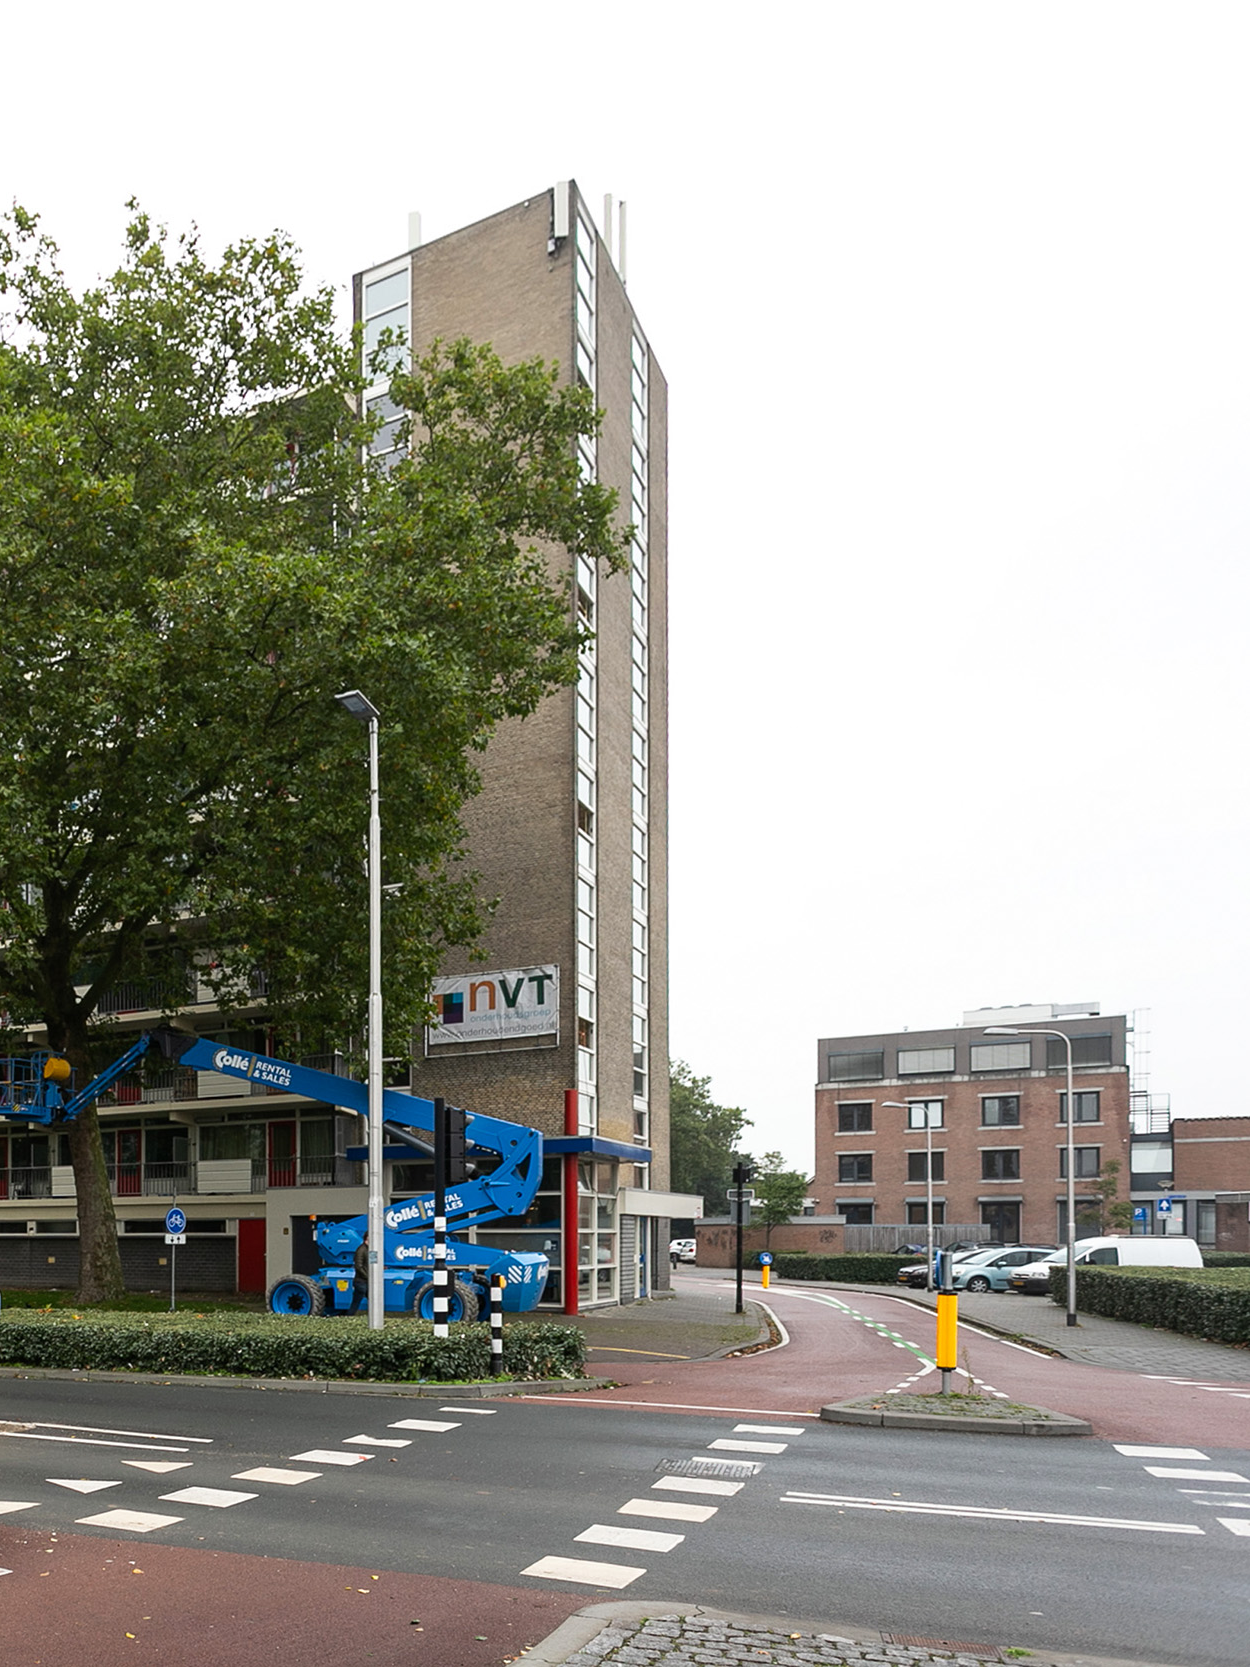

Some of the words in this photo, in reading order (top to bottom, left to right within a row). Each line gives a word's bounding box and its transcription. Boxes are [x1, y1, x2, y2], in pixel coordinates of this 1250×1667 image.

[214, 1049, 249, 1071] Collé
[253, 1070, 260, 1078] &
[261, 1071, 291, 1086] SALES
[255, 1061, 292, 1078] RENTAL
[424, 1193, 461, 1210] RETAL
[386, 1205, 419, 1229] Collé
[395, 1245, 423, 1260] Collé
